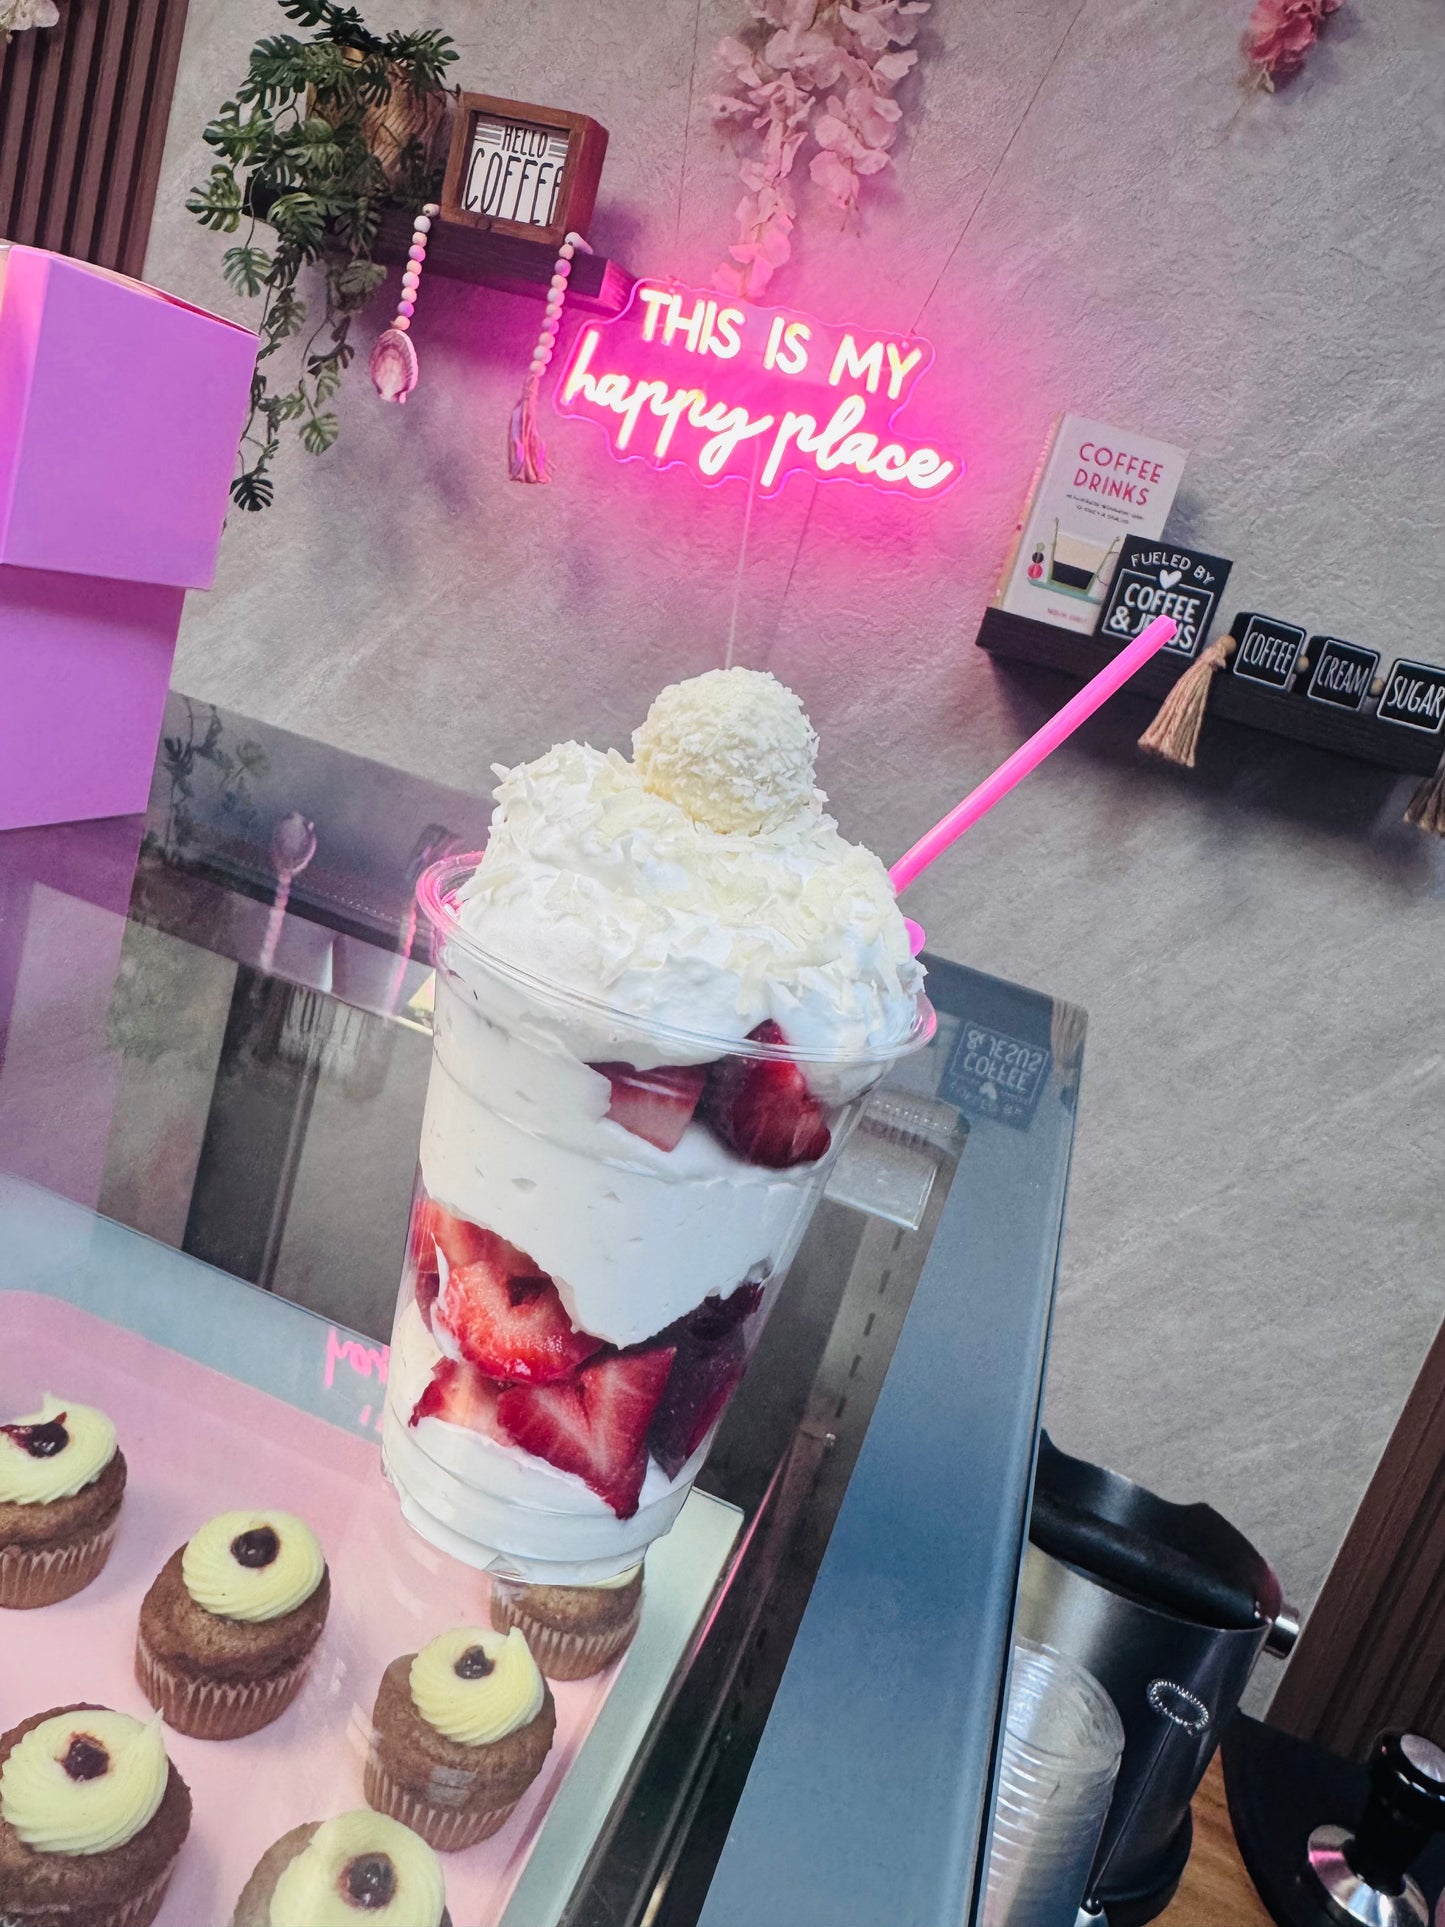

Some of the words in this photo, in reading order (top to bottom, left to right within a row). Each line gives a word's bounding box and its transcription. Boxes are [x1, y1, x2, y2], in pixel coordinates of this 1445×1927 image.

[501, 125, 549, 158] HELLO
[640, 288, 746, 359] THIS
[763, 316, 812, 374] IS
[829, 333, 922, 400] MY
[560, 330, 775, 477] happy
[759, 395, 954, 489] place
[1078, 442, 1164, 484] COFFEE
[1073, 468, 1150, 506] DRINKS
[1130, 551, 1191, 571] FUELED
[1193, 564, 1215, 586] BY
[1110, 605, 1132, 632] &
[1124, 582, 1201, 624] COFFEE
[1242, 631, 1296, 675] COFFEE
[1316, 654, 1371, 697] CREAM
[1387, 675, 1445, 718] SUGAR
